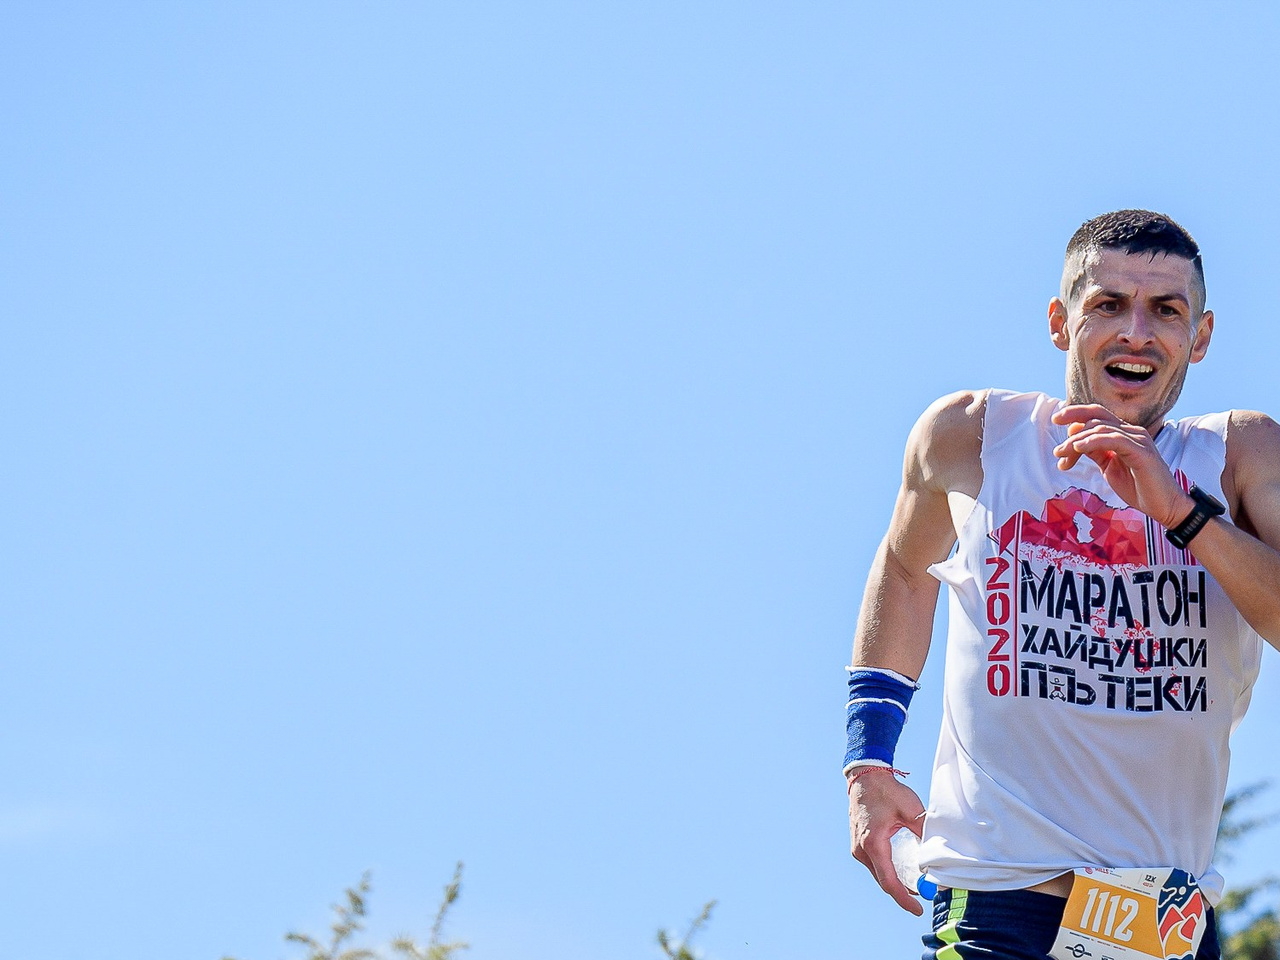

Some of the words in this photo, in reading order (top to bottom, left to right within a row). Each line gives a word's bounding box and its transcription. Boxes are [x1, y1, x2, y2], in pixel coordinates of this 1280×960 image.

[1020, 560, 1208, 628] МАРАТОН
[985, 557, 1011, 697] 2020
[1020, 623, 1208, 672] ХАЙДУШКИ
[1020, 661, 1208, 712] ПЪТЕКИ
[1080, 887, 1139, 942] 1112
